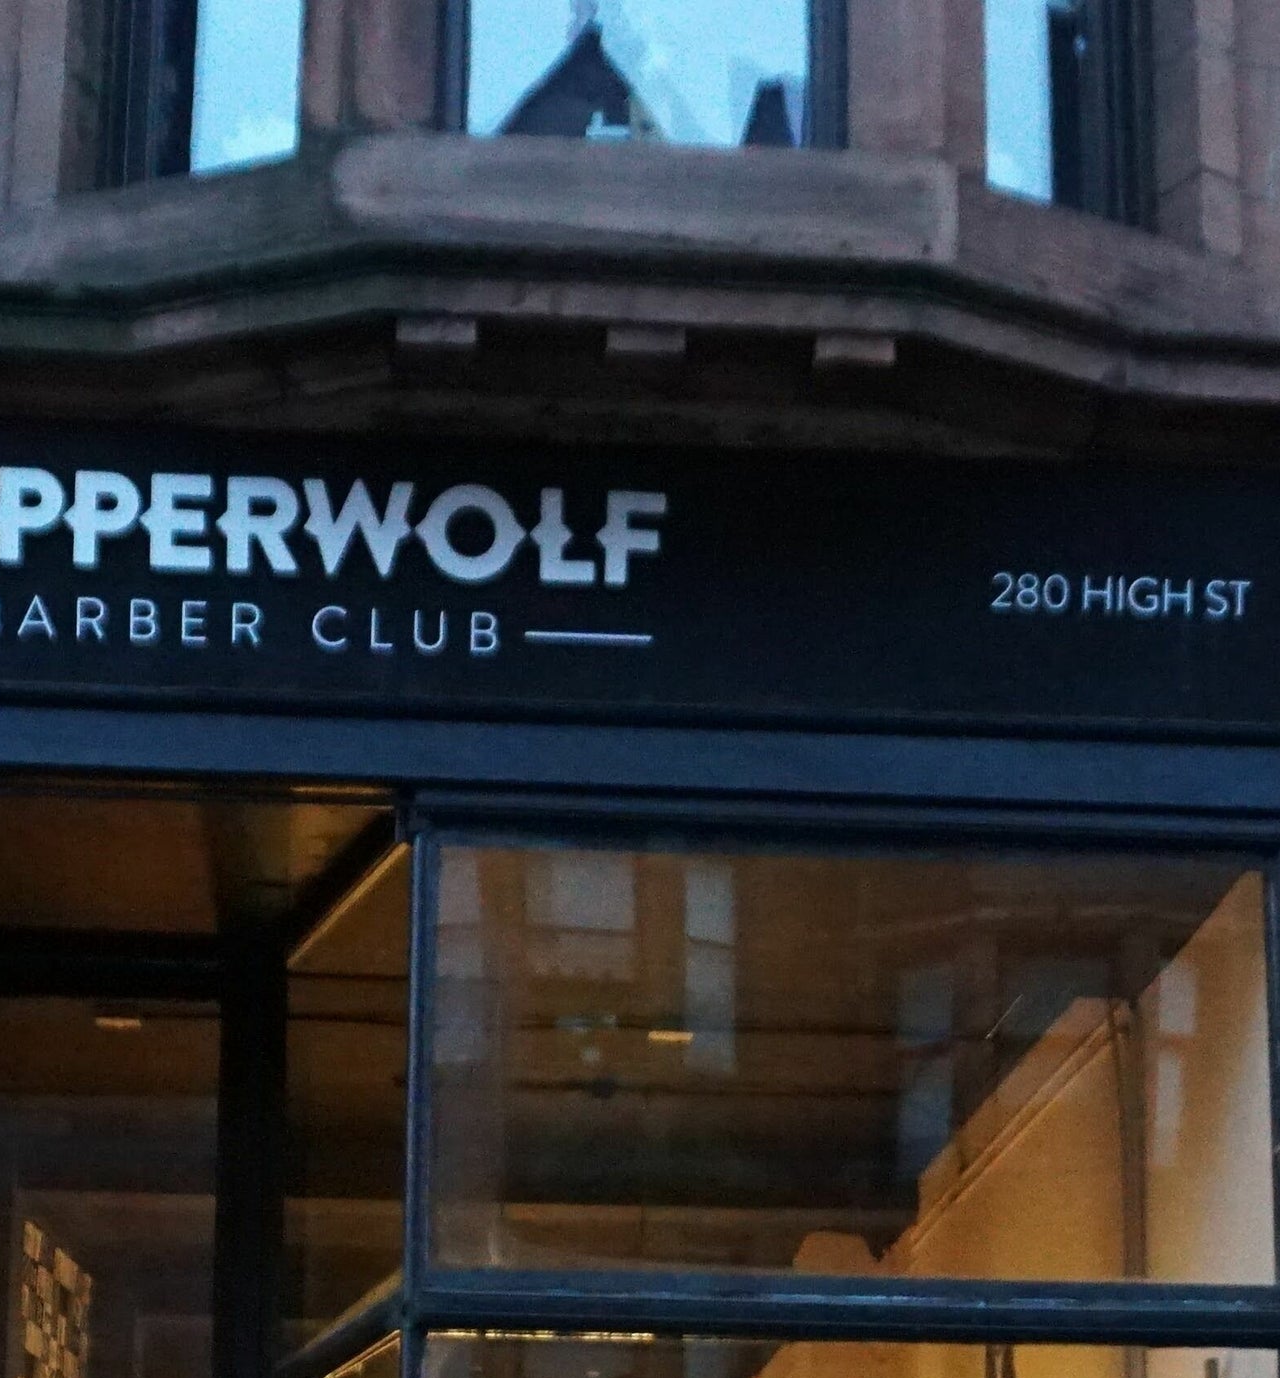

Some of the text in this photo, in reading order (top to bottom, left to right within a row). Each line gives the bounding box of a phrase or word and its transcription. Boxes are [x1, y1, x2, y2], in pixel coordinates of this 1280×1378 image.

[990, 572, 1251, 617] 280 HIGH ST
[311, 606, 499, 653] CLUB
